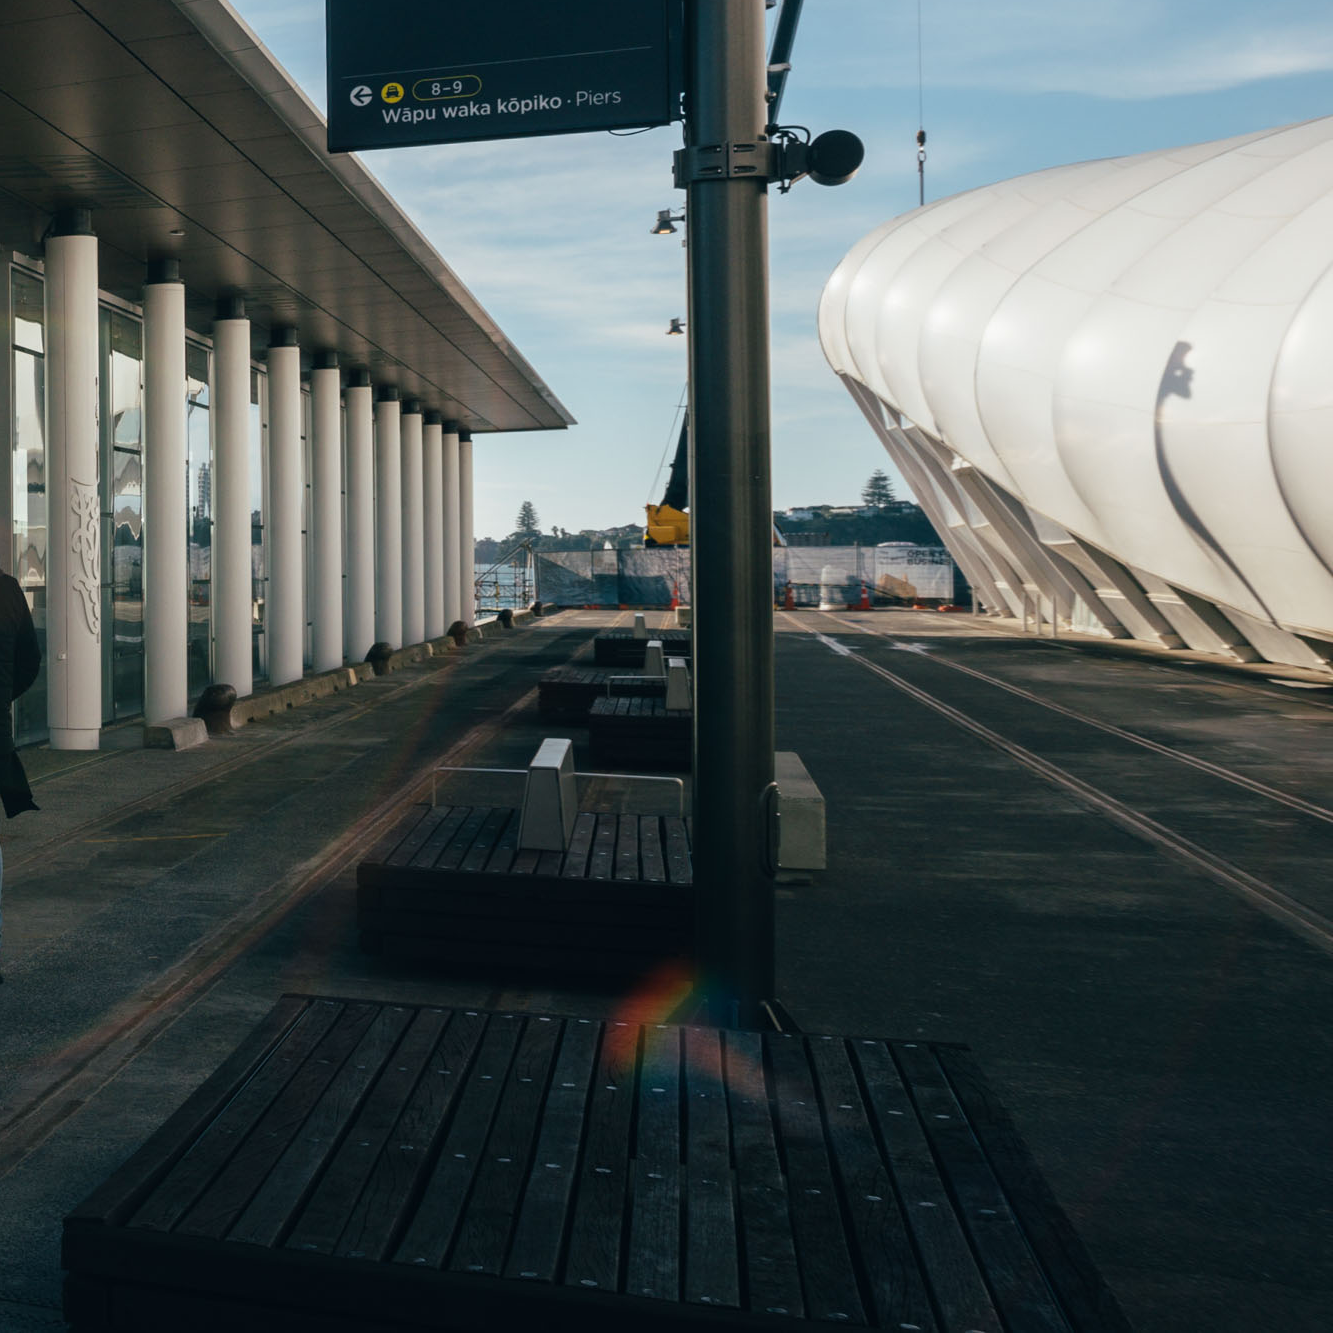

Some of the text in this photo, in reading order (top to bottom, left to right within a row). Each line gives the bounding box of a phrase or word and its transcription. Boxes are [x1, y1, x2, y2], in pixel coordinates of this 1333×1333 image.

[382, 90, 621, 124] Wāpu waka kōpiko Piers
